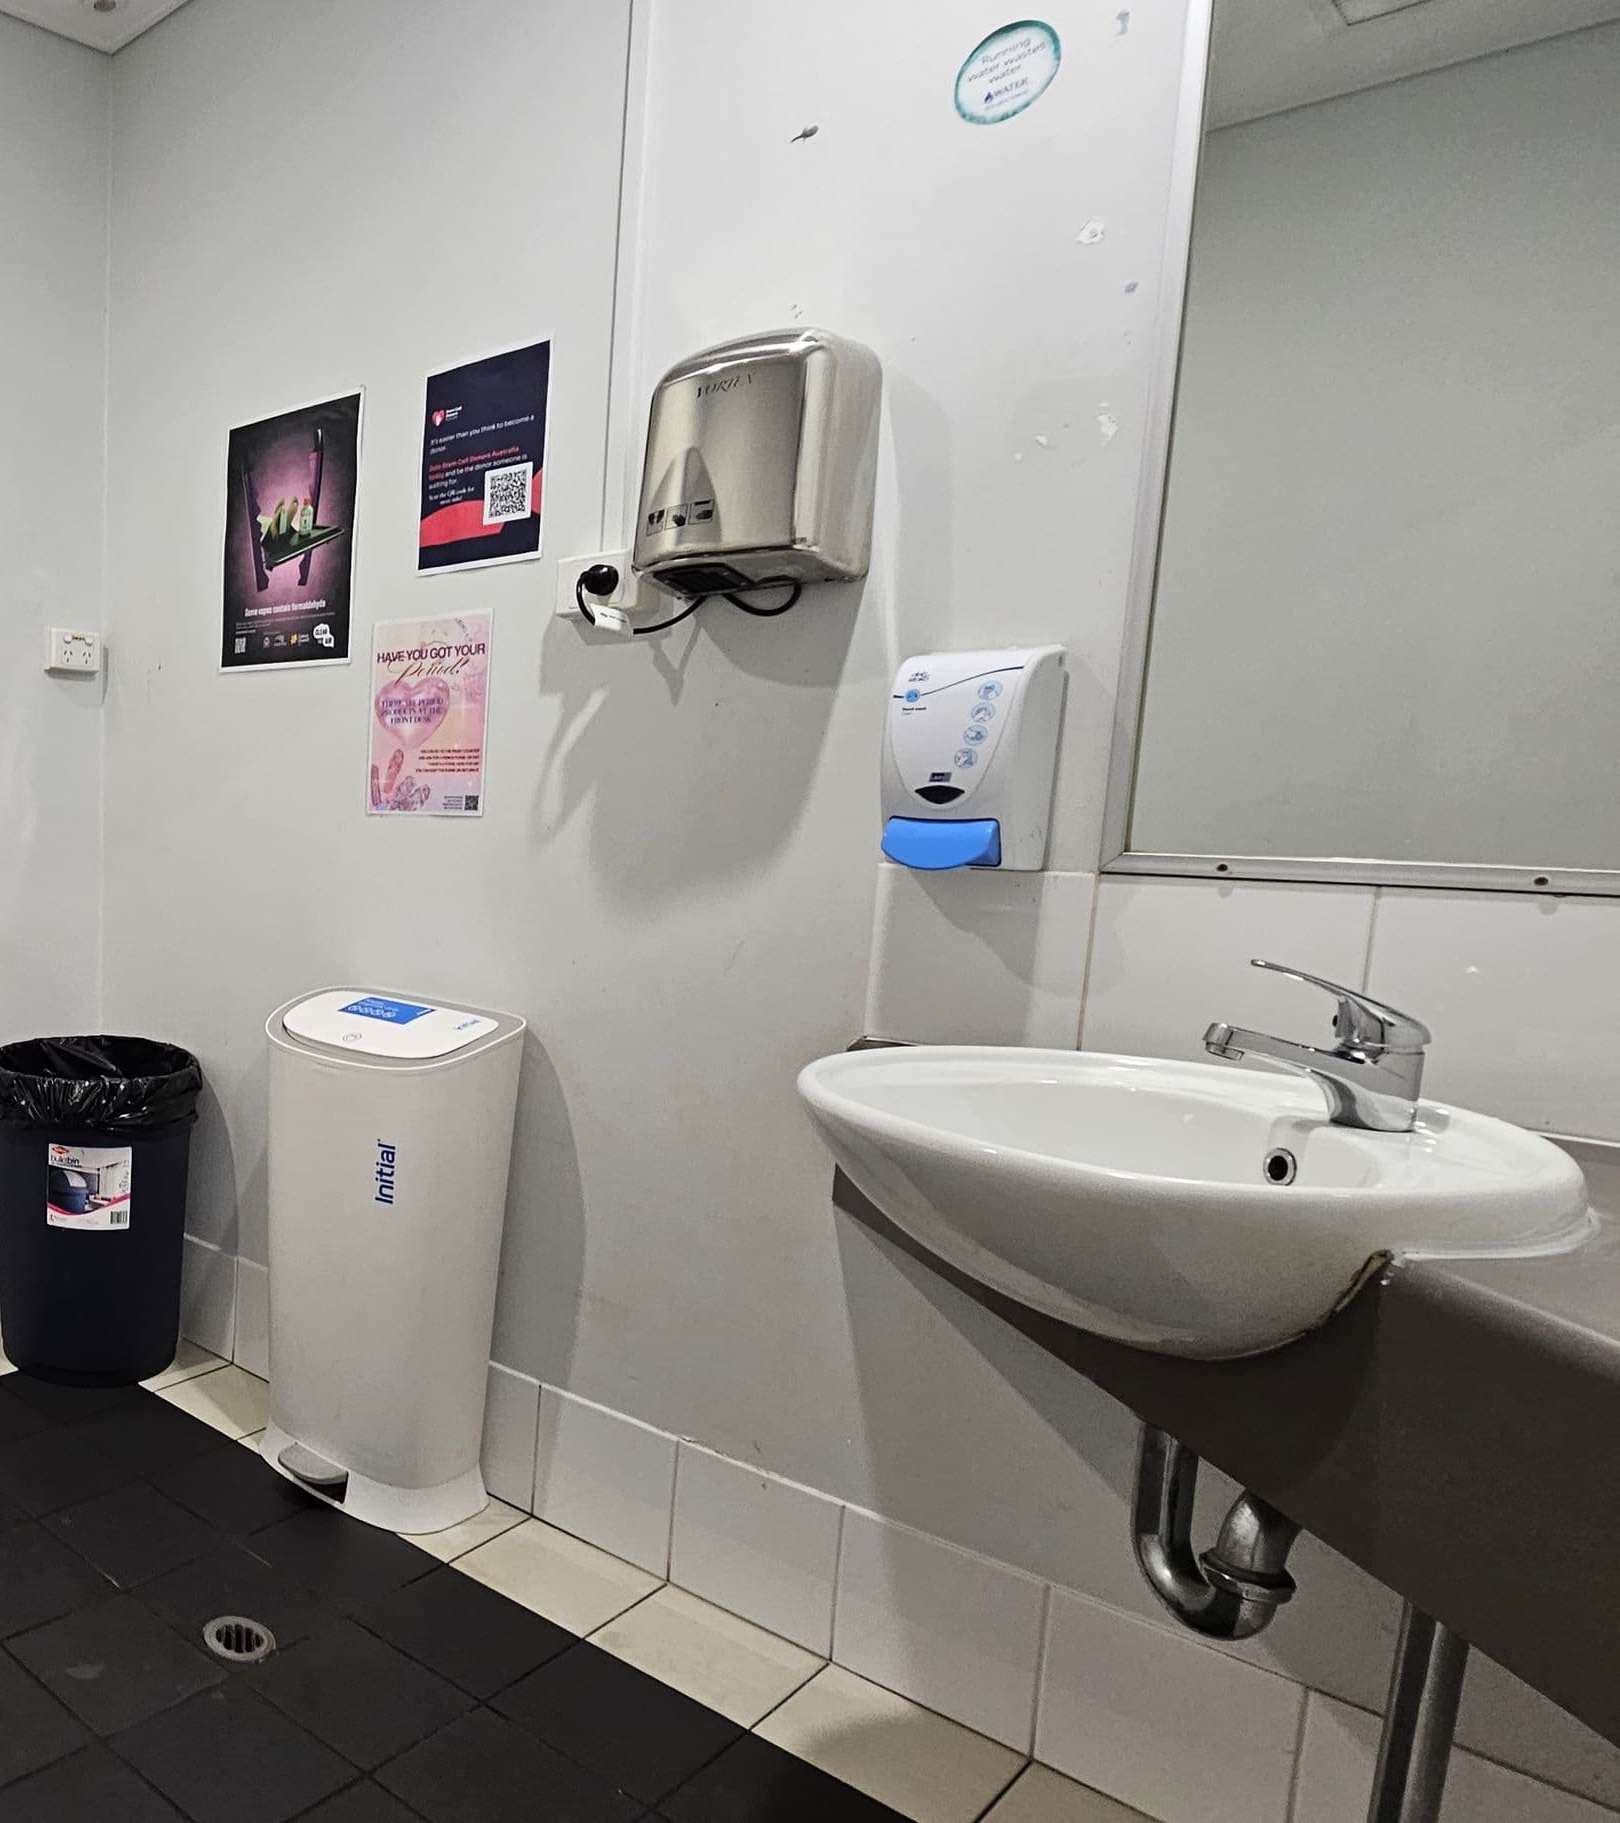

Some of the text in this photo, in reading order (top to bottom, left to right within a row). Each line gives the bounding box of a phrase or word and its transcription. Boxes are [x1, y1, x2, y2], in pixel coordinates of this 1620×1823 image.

[469, 429, 480, 437] you
[377, 643, 486, 664] HAVE YOU GOT YOUR
[375, 1141, 396, 1205] Initial
